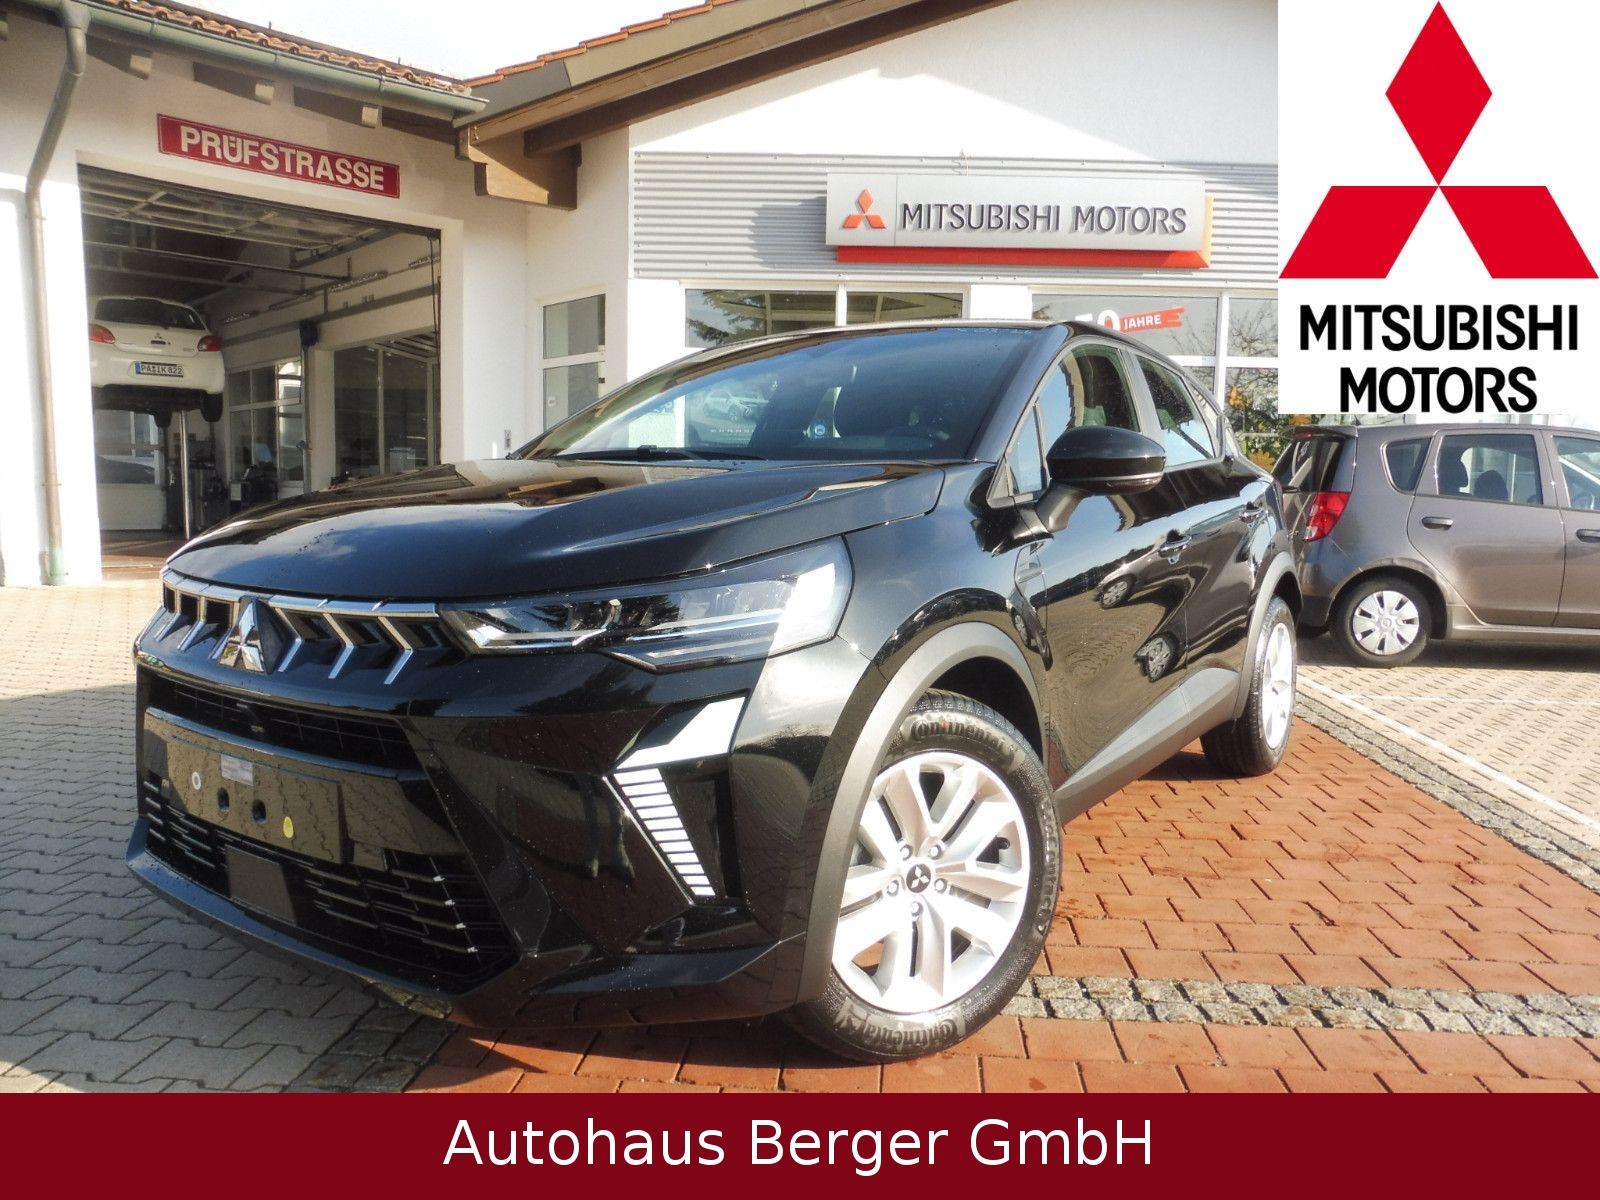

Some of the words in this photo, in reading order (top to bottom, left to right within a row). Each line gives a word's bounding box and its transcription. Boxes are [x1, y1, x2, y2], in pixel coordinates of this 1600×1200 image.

[180, 125, 384, 191] PRÜFSTRASSE
[902, 203, 1061, 231] MITSUBISHI
[1073, 205, 1187, 234] MOTORS
[1124, 314, 1161, 330] JAHRE
